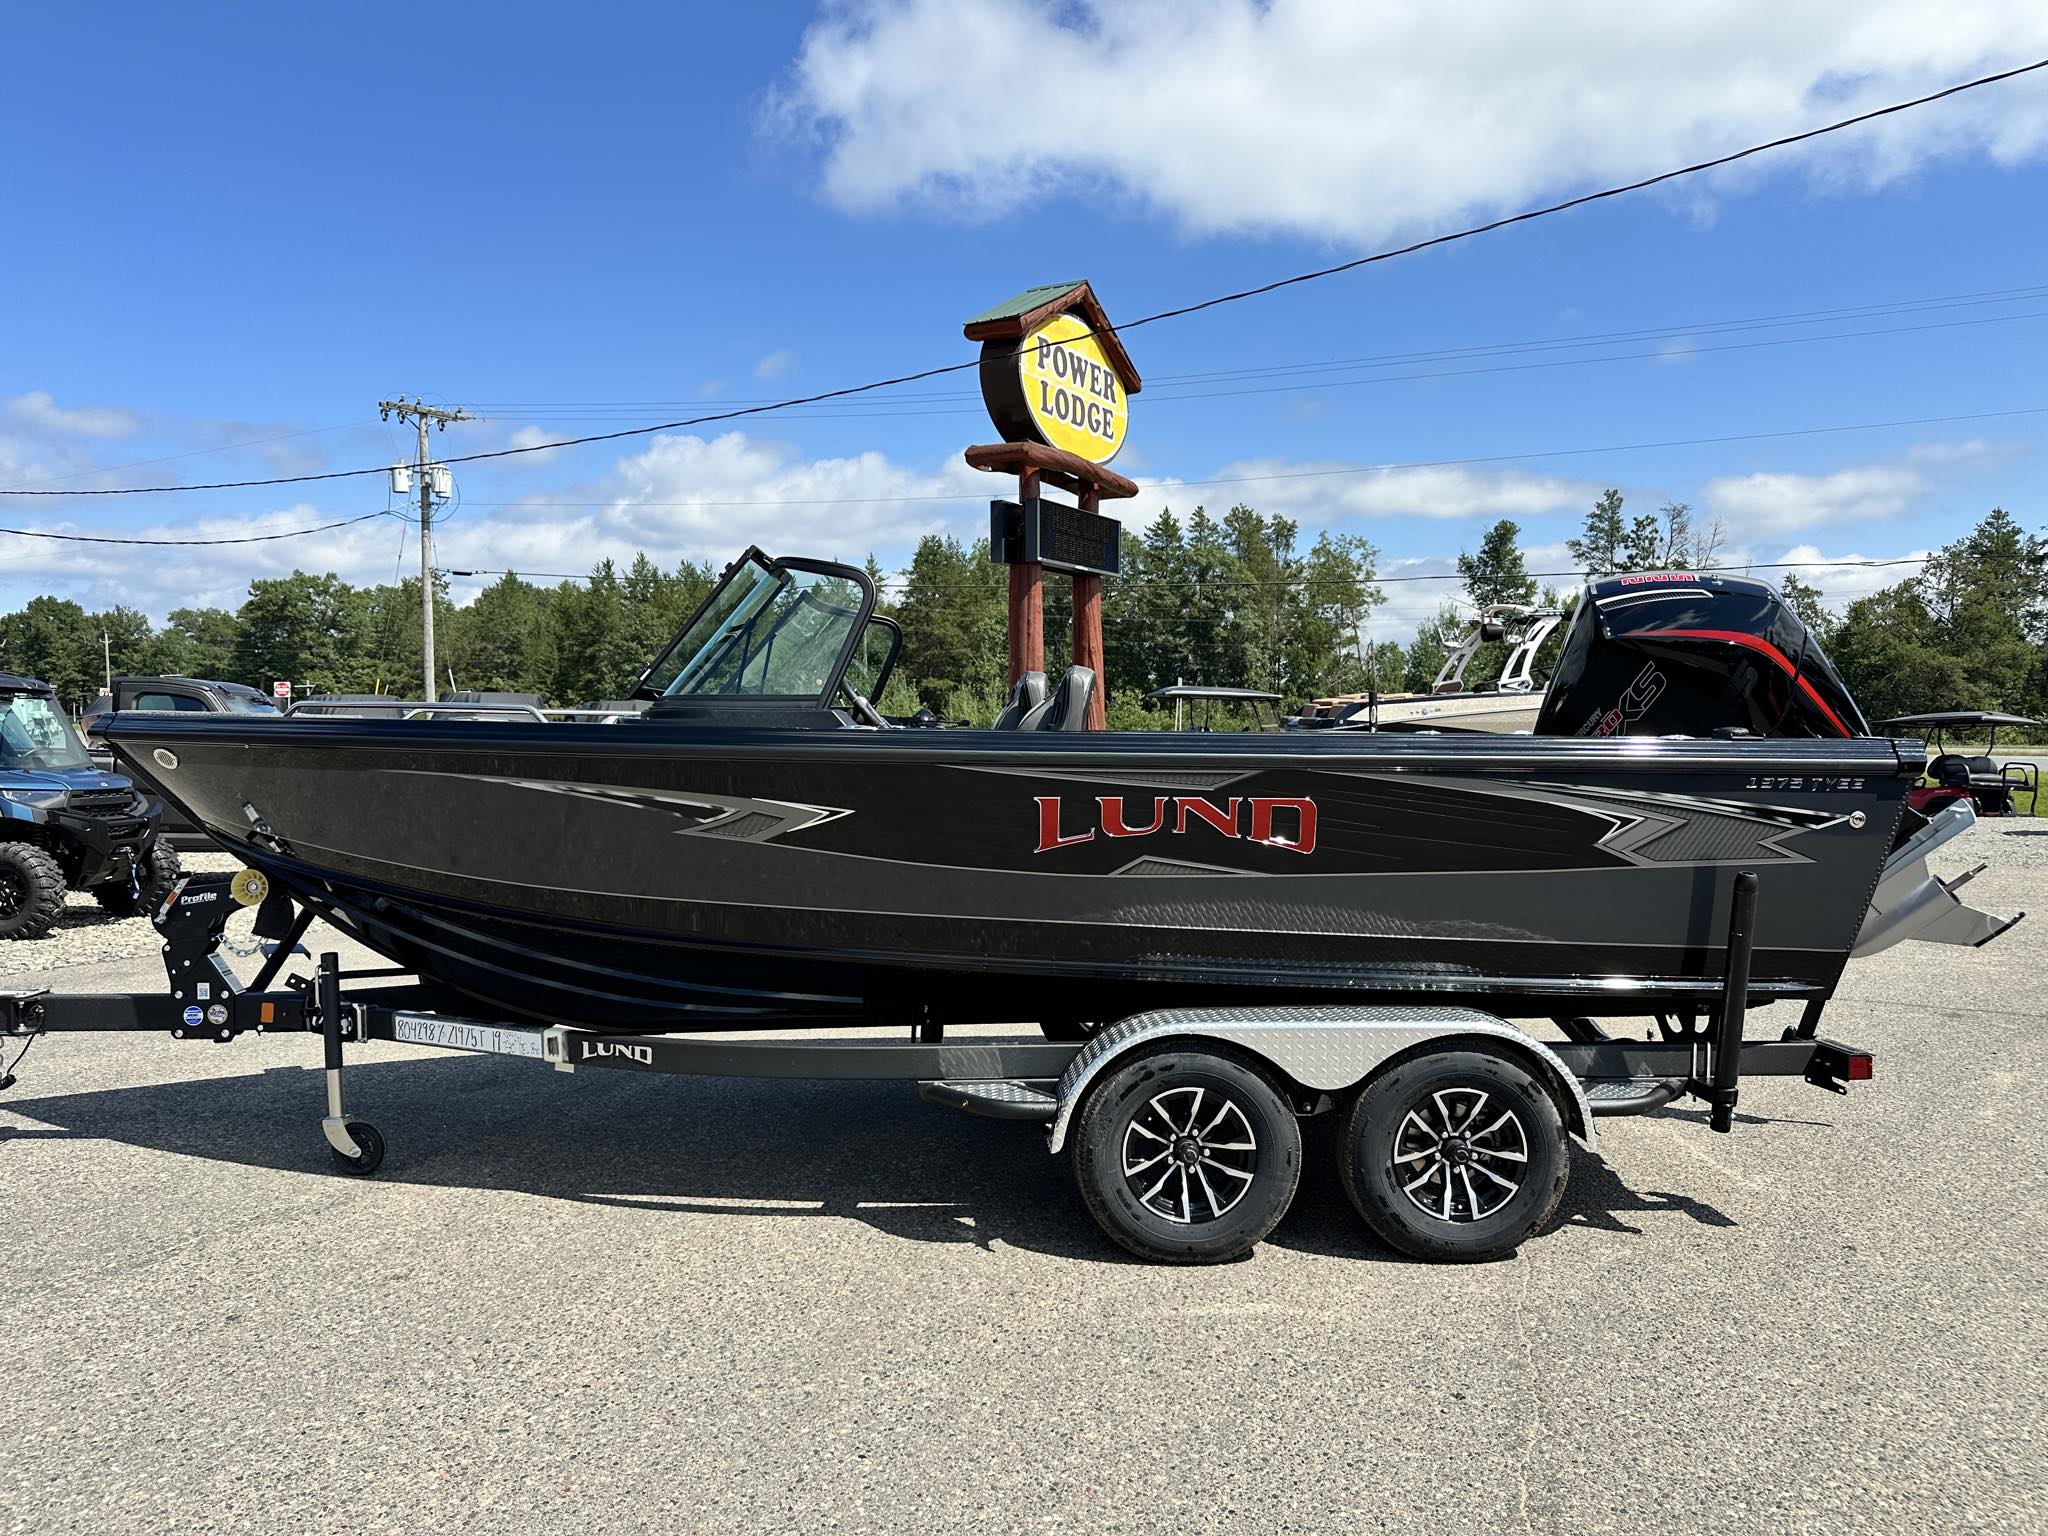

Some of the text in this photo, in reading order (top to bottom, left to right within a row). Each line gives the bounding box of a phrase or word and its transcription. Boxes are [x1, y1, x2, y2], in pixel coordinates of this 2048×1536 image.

[1036, 335, 1117, 404] POWER
[1040, 379, 1115, 441] LODGE
[1745, 777, 1865, 792] 1975 TYEE
[1033, 796, 1318, 855] LUND
[180, 891, 218, 904] Profile
[397, 1019, 436, 1042] 804298
[581, 1040, 653, 1065] LUND
